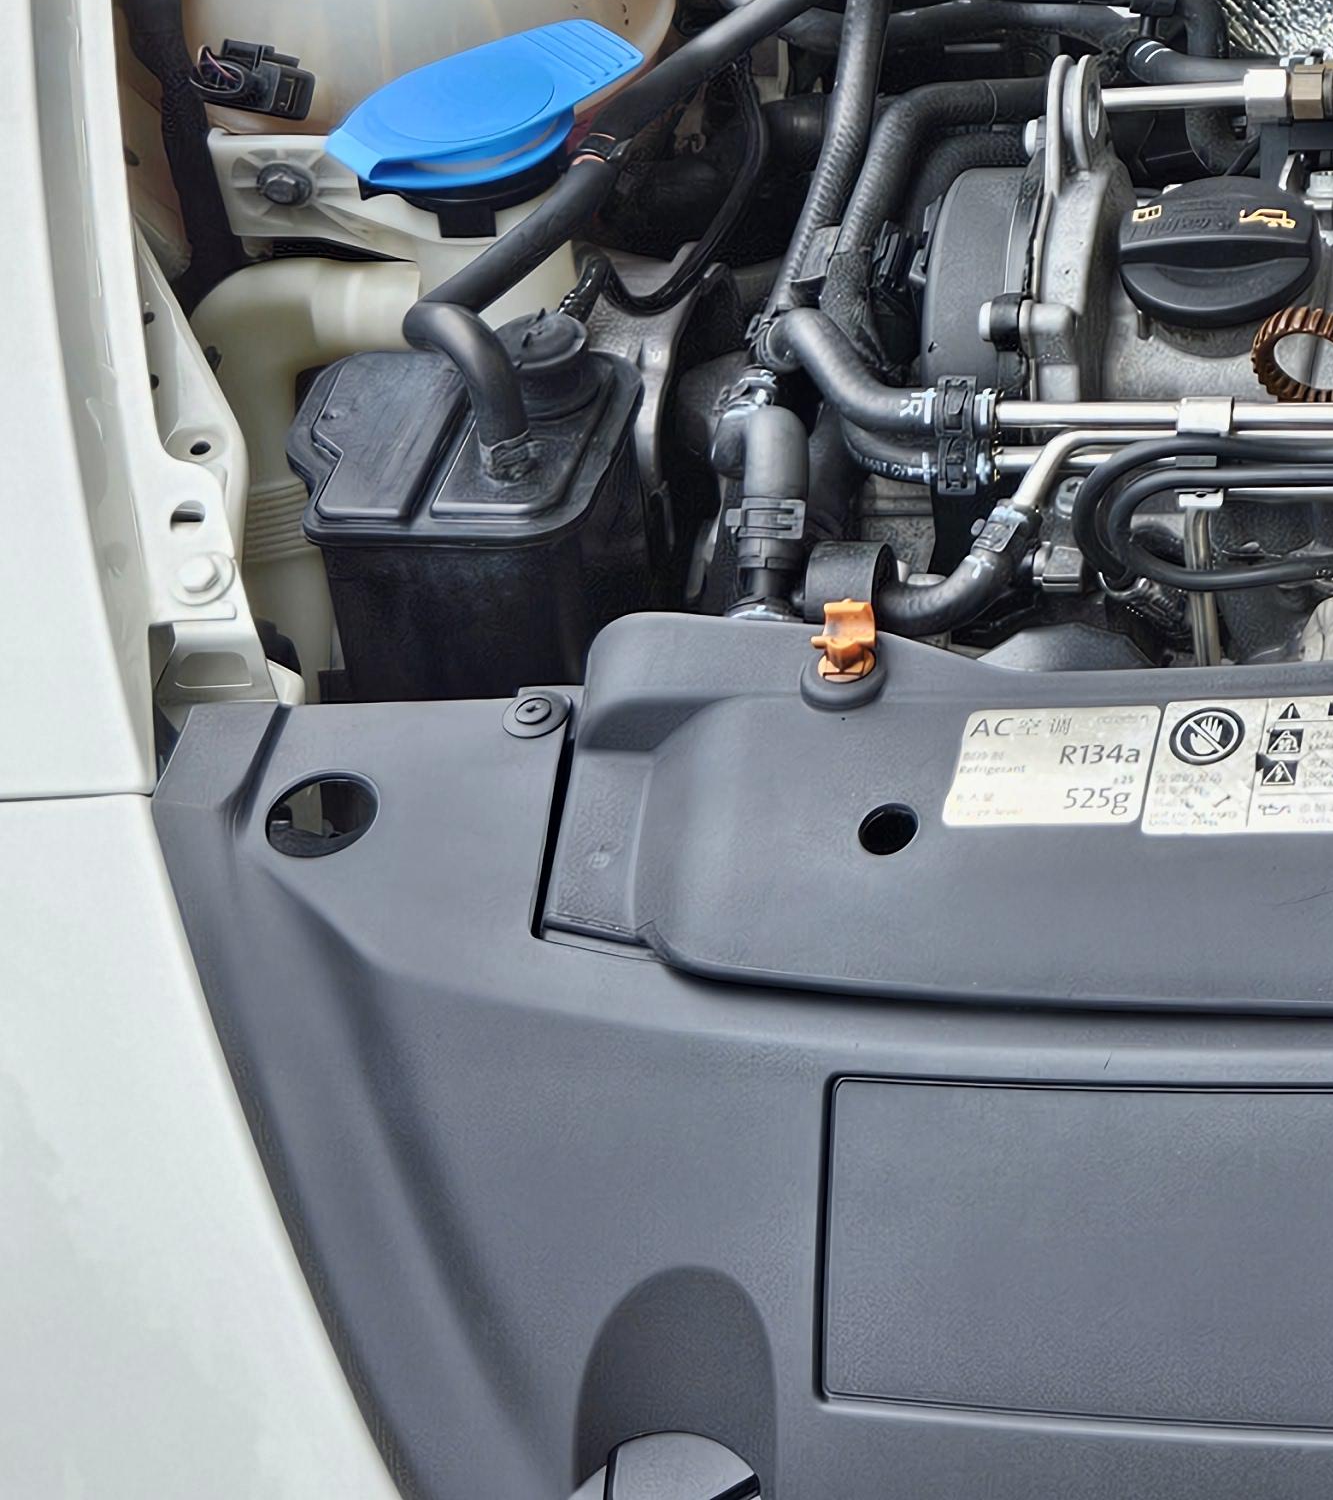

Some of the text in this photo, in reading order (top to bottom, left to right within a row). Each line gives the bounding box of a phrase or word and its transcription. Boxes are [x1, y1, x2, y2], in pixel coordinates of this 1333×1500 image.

[970, 718, 1013, 737] AC
[1059, 744, 1140, 765] R134a
[958, 763, 1027, 776] Refrigerant
[1063, 787, 1131, 816] 525g
